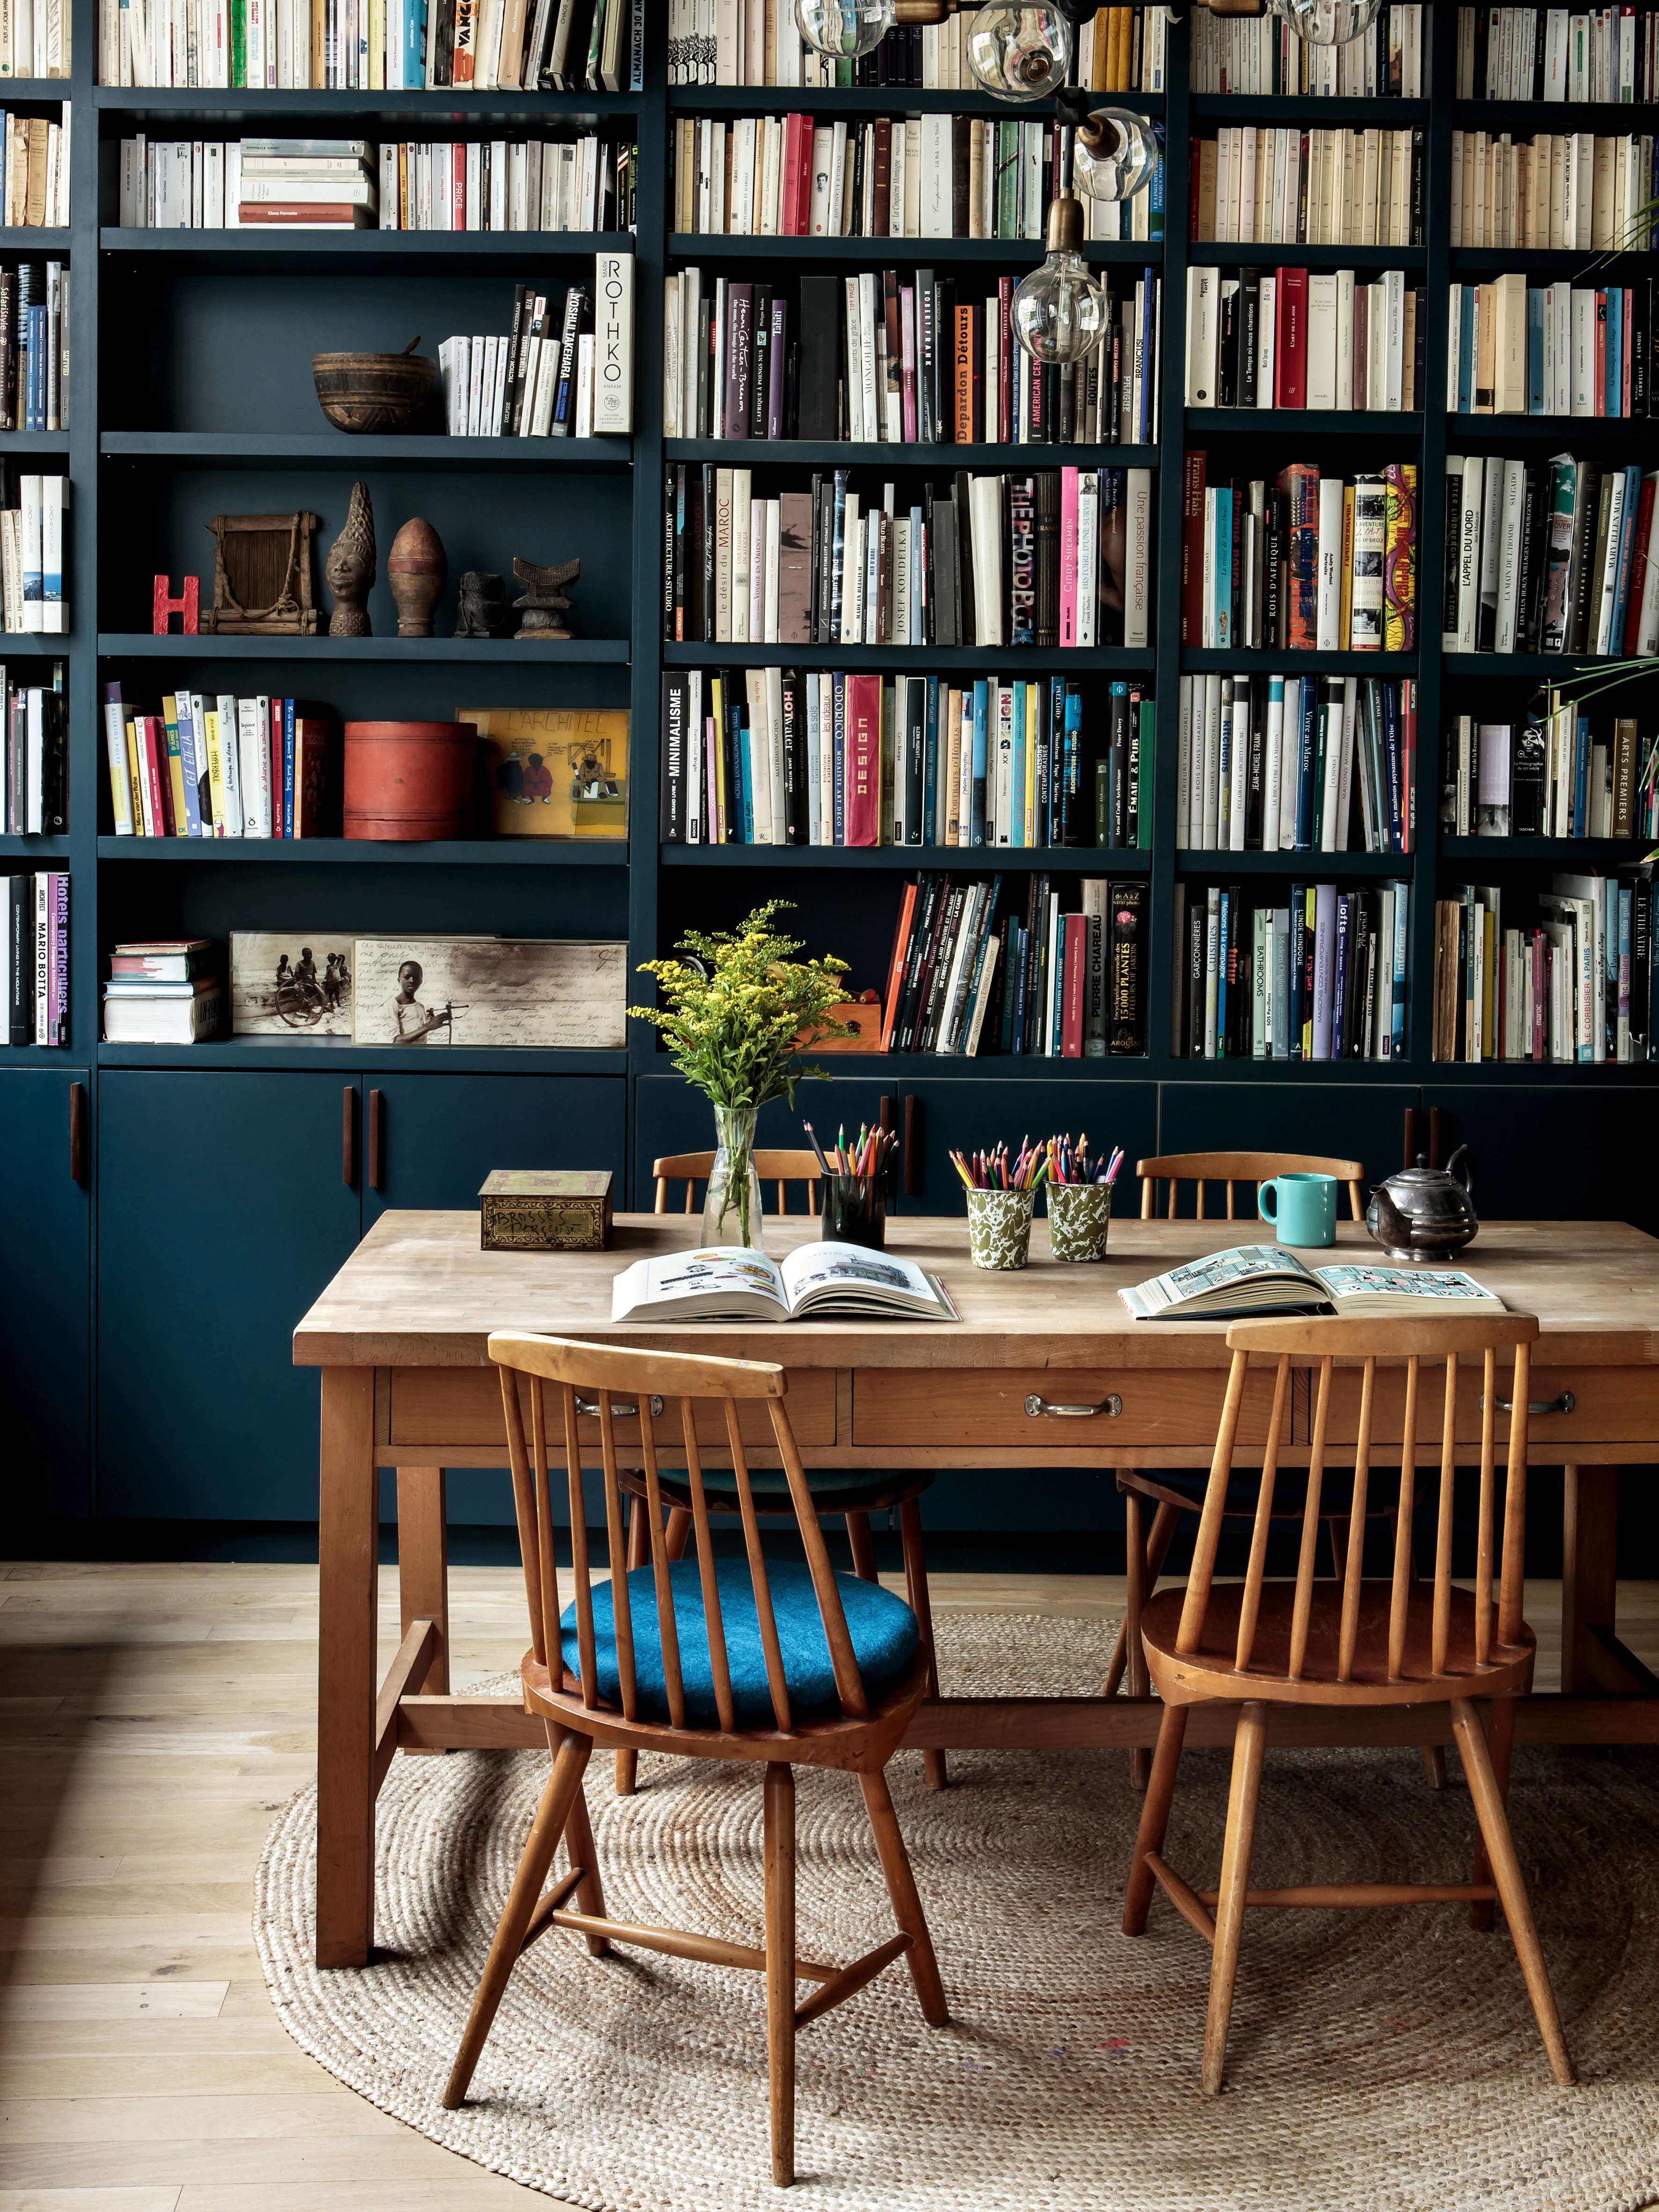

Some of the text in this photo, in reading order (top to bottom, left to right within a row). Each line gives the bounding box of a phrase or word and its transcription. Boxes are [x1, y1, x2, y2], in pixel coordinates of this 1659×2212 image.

[634, 15, 642, 84] ALMANACH 30
[560, 295, 580, 379] YOSHIJI TAKEHARA
[604, 260, 622, 381] ROTHKO
[739, 299, 749, 328] Henri
[773, 311, 782, 336] Tahiti
[958, 308, 968, 441] Depardon Détours
[1088, 367, 1098, 406] ROUTES
[1192, 457, 1203, 516] Frans Hals
[1465, 510, 1473, 536] NORD
[719, 499, 729, 613] le désir du MAROC
[1134, 491, 1147, 610] Une passion française
[1462, 554, 1472, 586] L'APPEL
[154, 575, 199, 634] H
[897, 529, 907, 633] JOSEF KOUDELKA
[668, 689, 681, 776] MINIMALISME
[834, 686, 843, 739] ODORICO
[211, 751, 219, 782] HYPERBOLE
[857, 718, 868, 795] DESIGN
[1222, 720, 1231, 773] kitchens
[186, 767, 197, 786] CET
[1619, 769, 1628, 820] PREMIERS
[1638, 898, 1645, 909] LE
[58, 877, 68, 1013] Hotels particuliers
[1092, 914, 1102, 1018] PIERRE CHAREAU
[1121, 943, 1129, 986] PLANTES
[1193, 921, 1202, 979] GARÇONNIÈRES
[1207, 925, 1217, 972] Cuisines
[949, 1017, 959, 1046] casterman
[1585, 1034, 1591, 1044] LE
